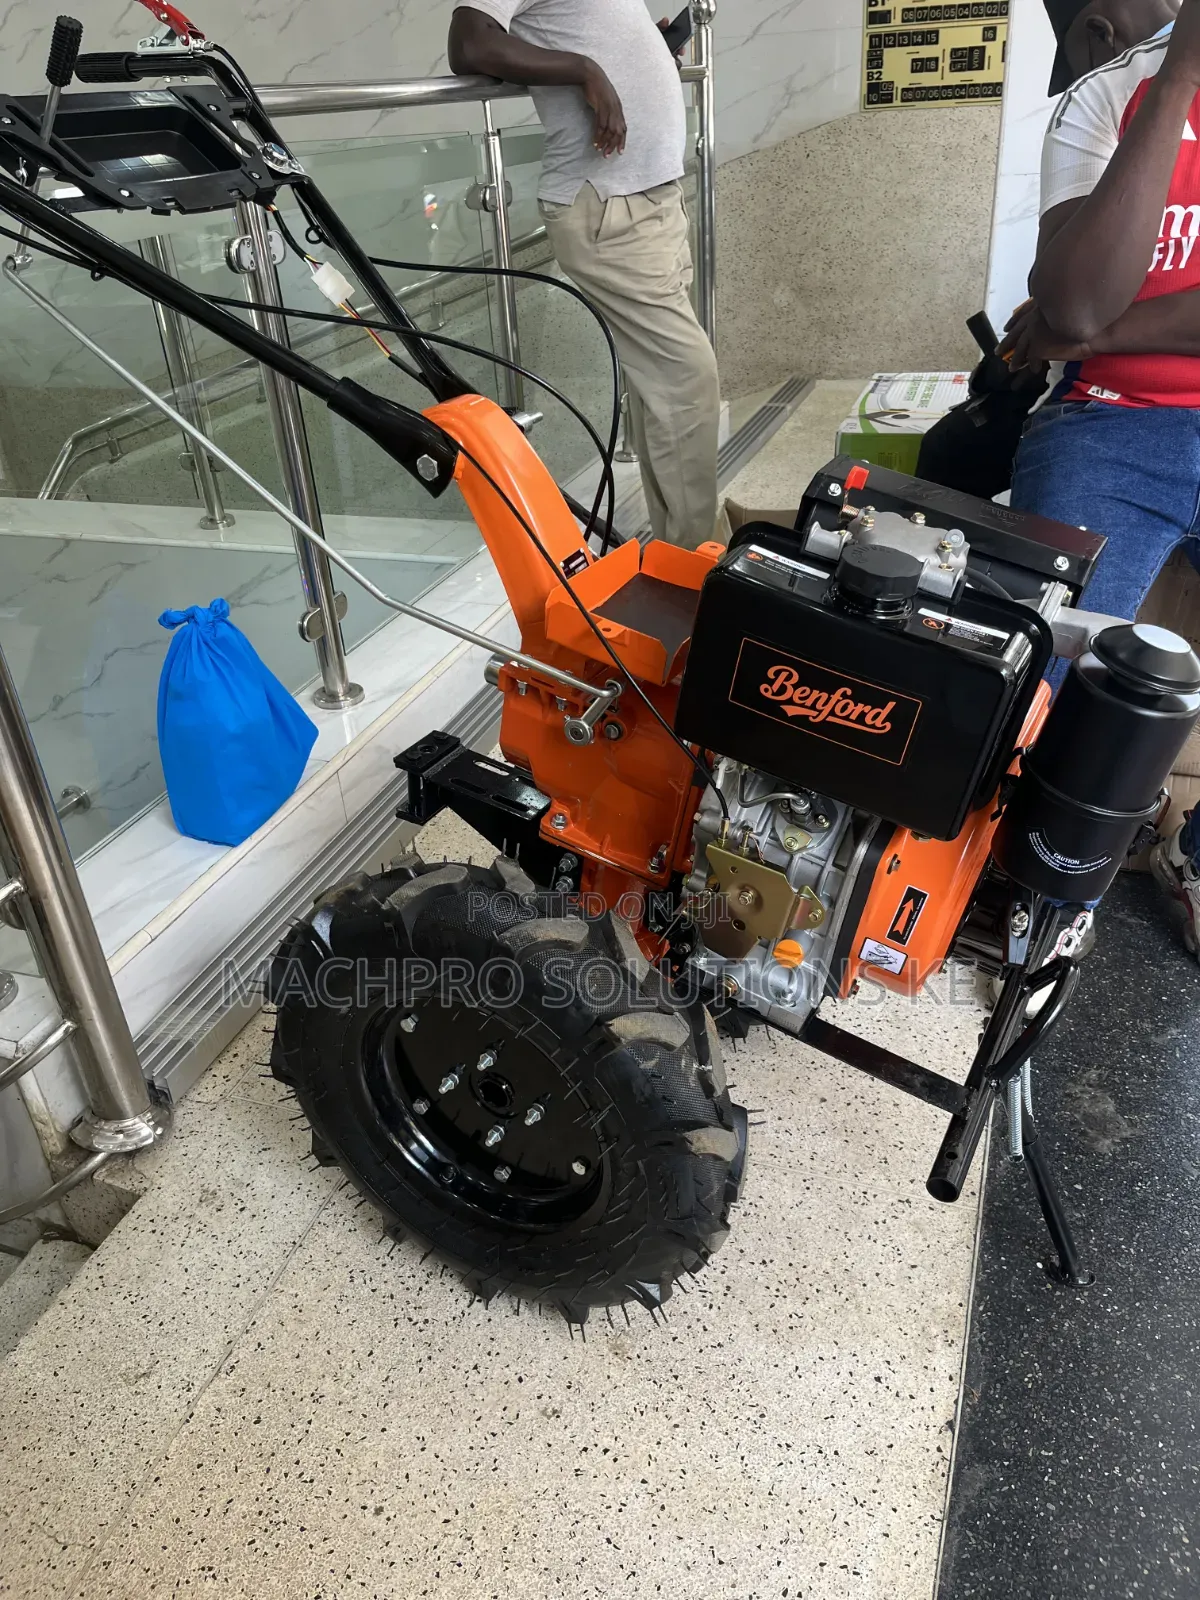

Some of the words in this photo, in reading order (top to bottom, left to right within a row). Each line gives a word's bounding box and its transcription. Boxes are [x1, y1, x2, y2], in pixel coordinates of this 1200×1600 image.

[916, 10, 928, 19] 07
[929, 9, 941, 18] 06
[944, 8, 956, 17] 05
[958, 7, 969, 16] 04
[972, 6, 984, 15] 03
[986, 5, 998, 14] 02
[872, 37, 879, 46] 11
[885, 36, 895, 45] 12
[899, 35, 909, 44] 13
[913, 34, 922, 43] 14
[927, 33, 937, 42] 15
[984, 30, 994, 39] 16
[952, 50, 967, 58] LIFT
[912, 61, 922, 70] 17
[926, 60, 936, 69] 18
[951, 62, 966, 70] LIFT
[867, 71, 883, 81] B2
[869, 93, 878, 102] 10
[915, 90, 926, 99] 07
[928, 89, 939, 98] 06
[942, 88, 953, 97] 05
[955, 88, 966, 97] 04
[969, 86, 980, 95] 03
[982, 86, 993, 94] 02
[1147, 236, 1198, 272] FLY
[759, 665, 896, 734] Benford
[1053, 852, 1080, 865] CAUTION
